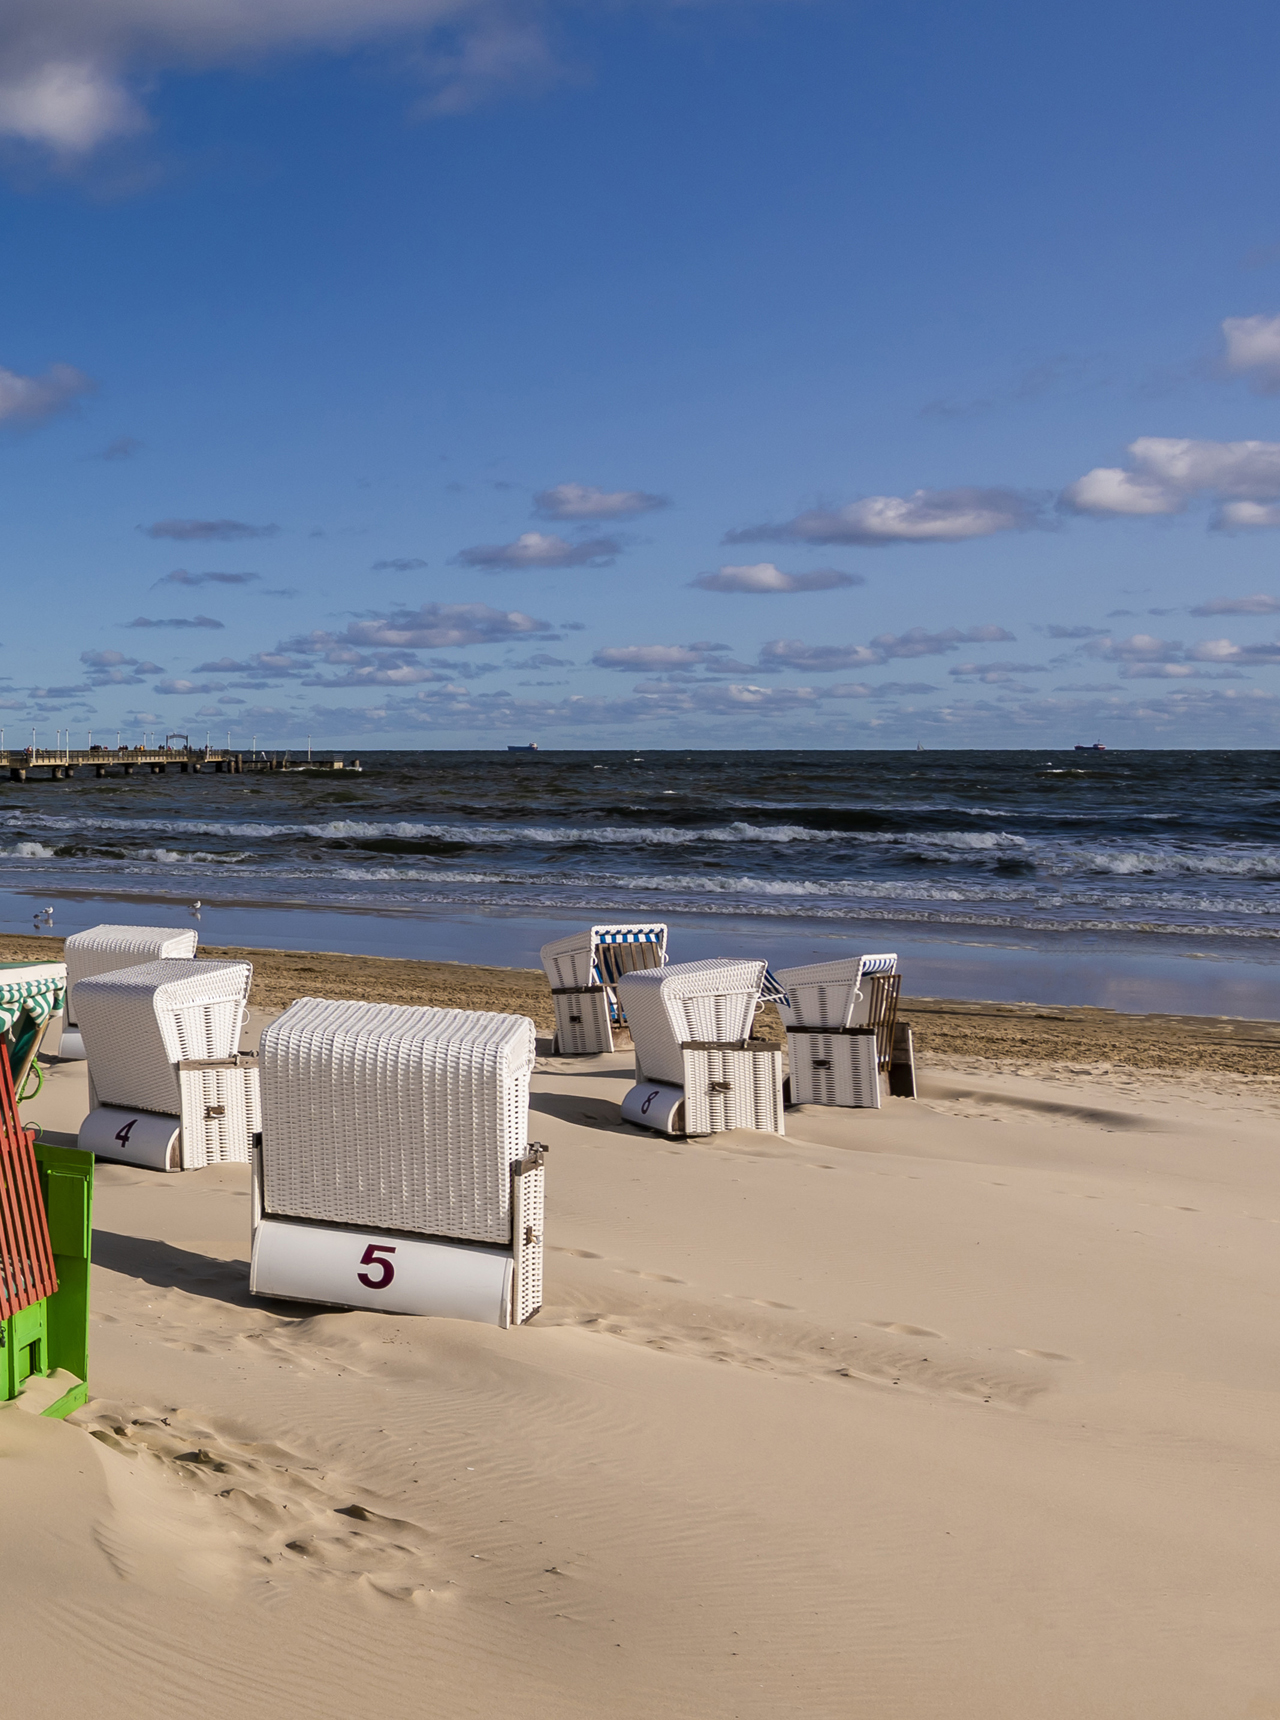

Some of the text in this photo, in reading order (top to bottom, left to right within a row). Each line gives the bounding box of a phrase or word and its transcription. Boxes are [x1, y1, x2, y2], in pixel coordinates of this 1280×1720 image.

[641, 1090, 660, 1115] 8
[114, 1118, 139, 1149] 4
[356, 1243, 397, 1290] 5
